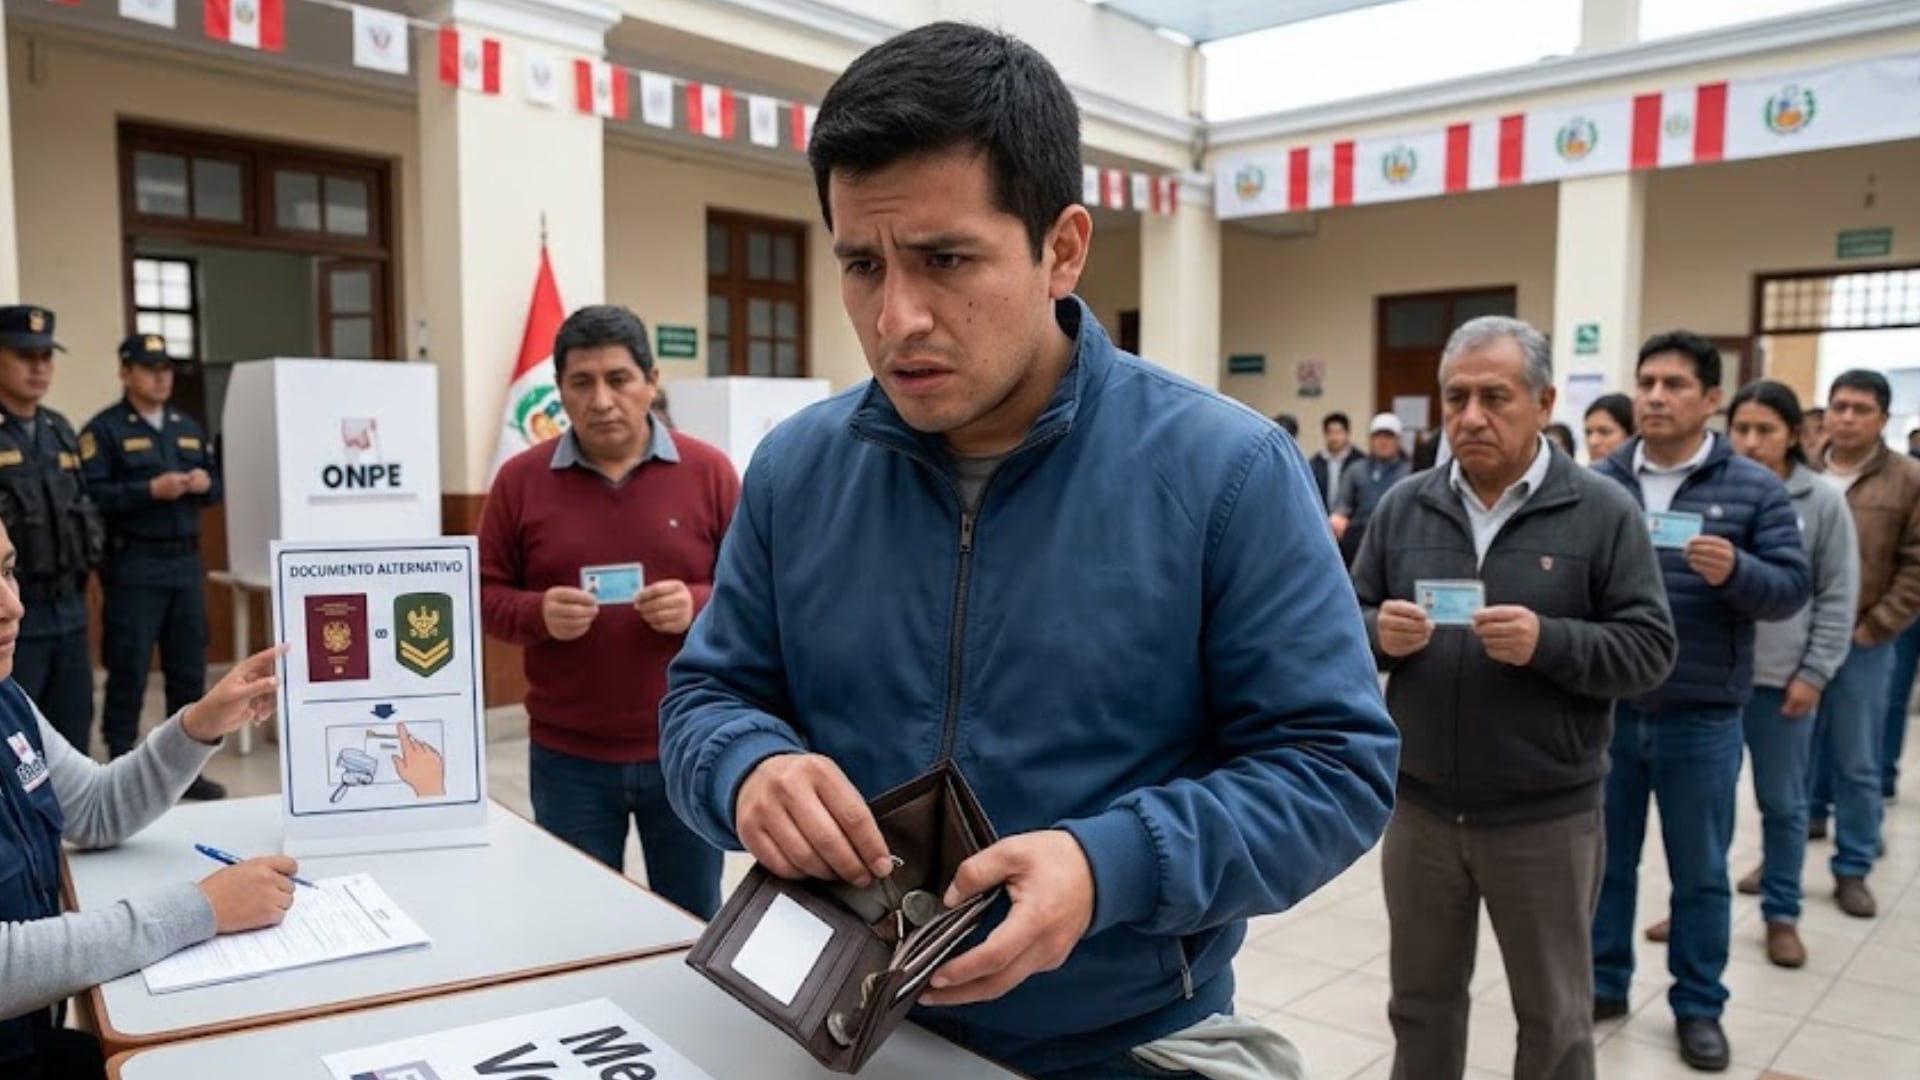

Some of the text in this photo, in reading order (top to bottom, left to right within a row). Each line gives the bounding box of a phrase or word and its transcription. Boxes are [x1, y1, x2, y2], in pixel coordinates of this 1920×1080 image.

[322, 463, 402, 489] ONPE
[289, 560, 463, 578] DOCUMENTO ALTERNATIVO
